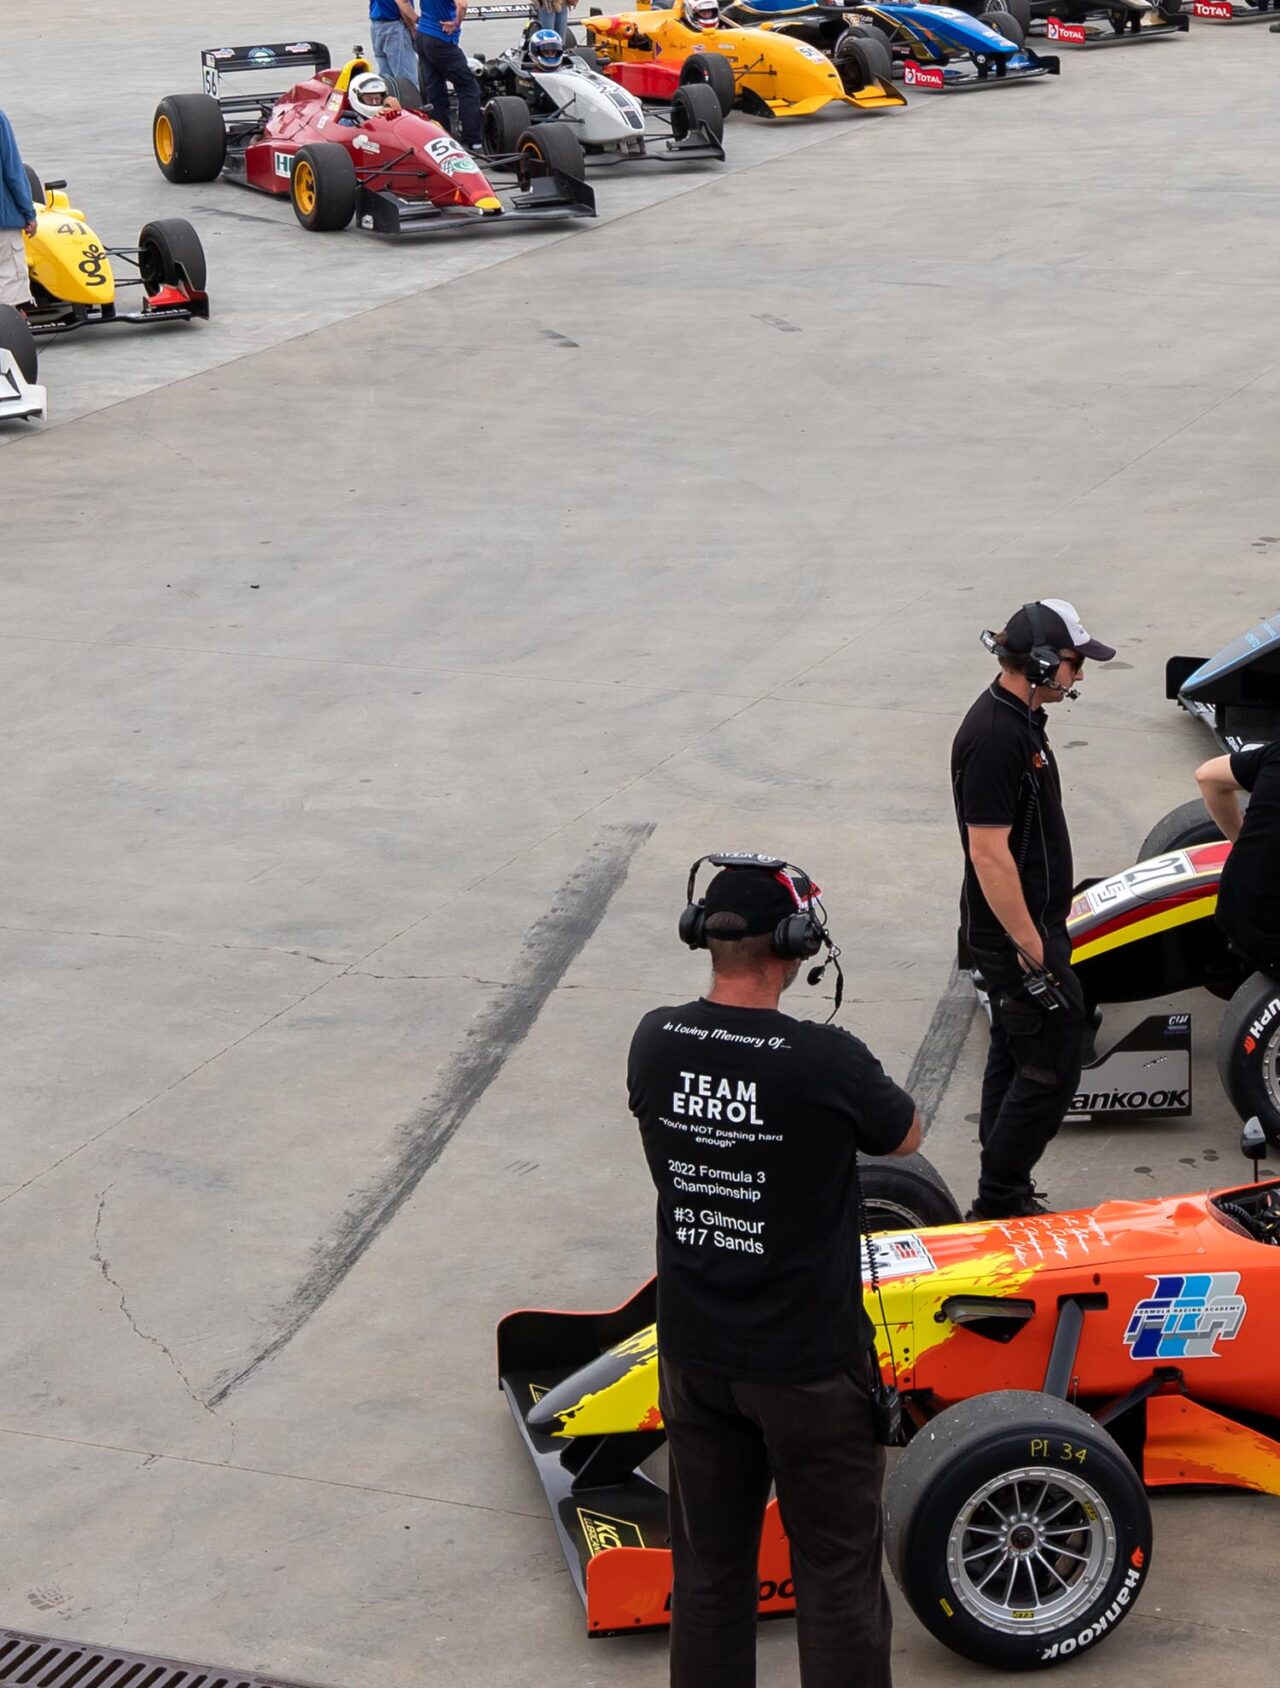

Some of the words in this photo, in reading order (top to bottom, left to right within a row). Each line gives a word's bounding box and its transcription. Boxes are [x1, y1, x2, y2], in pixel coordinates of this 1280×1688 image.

[1195, 2, 1231, 17] TOTAL
[1058, 28, 1084, 40] TOTAL
[205, 69, 217, 97] 56
[915, 72, 943, 85] TOTAL
[57, 223, 87, 236] 41
[662, 1021, 673, 1031] In
[674, 1023, 709, 1040] Loving
[711, 1029, 766, 1048] Memory
[680, 1071, 757, 1102] TEAM
[673, 1091, 764, 1125] ERROL
[1070, 1088, 1190, 1111] ankook
[690, 1124, 713, 1135] NOT
[716, 1129, 756, 1142] pushing
[758, 1133, 784, 1142] hard
[695, 1136, 736, 1148] enough"
[667, 1159, 696, 1177] 2022
[699, 1165, 753, 1183] Formula
[756, 1171, 766, 1184] 3
[673, 1176, 762, 1203] Championship
[673, 1206, 696, 1223] #3
[699, 1209, 766, 1235] Gilmour
[675, 1226, 708, 1246] #17
[713, 1230, 765, 1255] Sands
[1060, 1442, 1088, 1465] 34
[593, 1519, 623, 1548] KC
